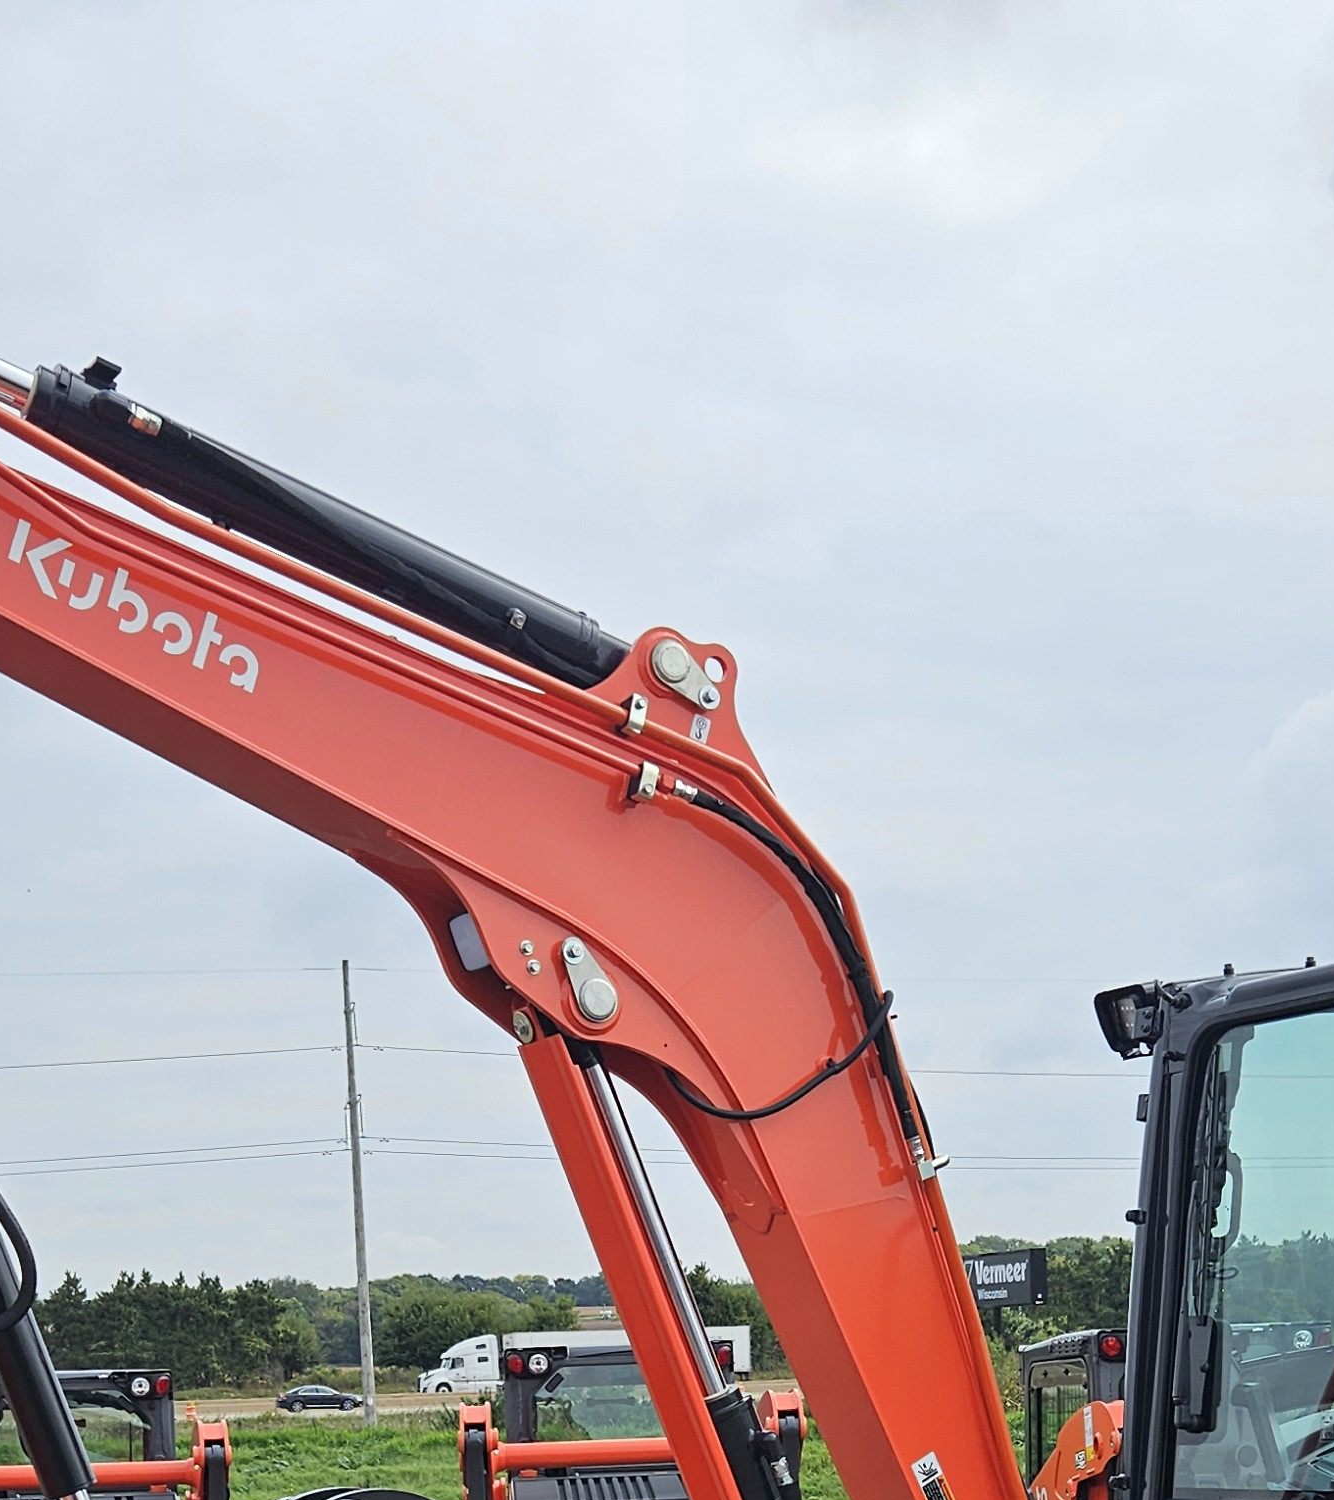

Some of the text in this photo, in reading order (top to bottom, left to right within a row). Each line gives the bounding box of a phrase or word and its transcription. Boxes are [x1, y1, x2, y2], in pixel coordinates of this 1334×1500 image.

[8, 518, 259, 693] Kubota
[974, 1260, 1027, 1285] Vermeer
[977, 1288, 1008, 1300] Wisconsin
